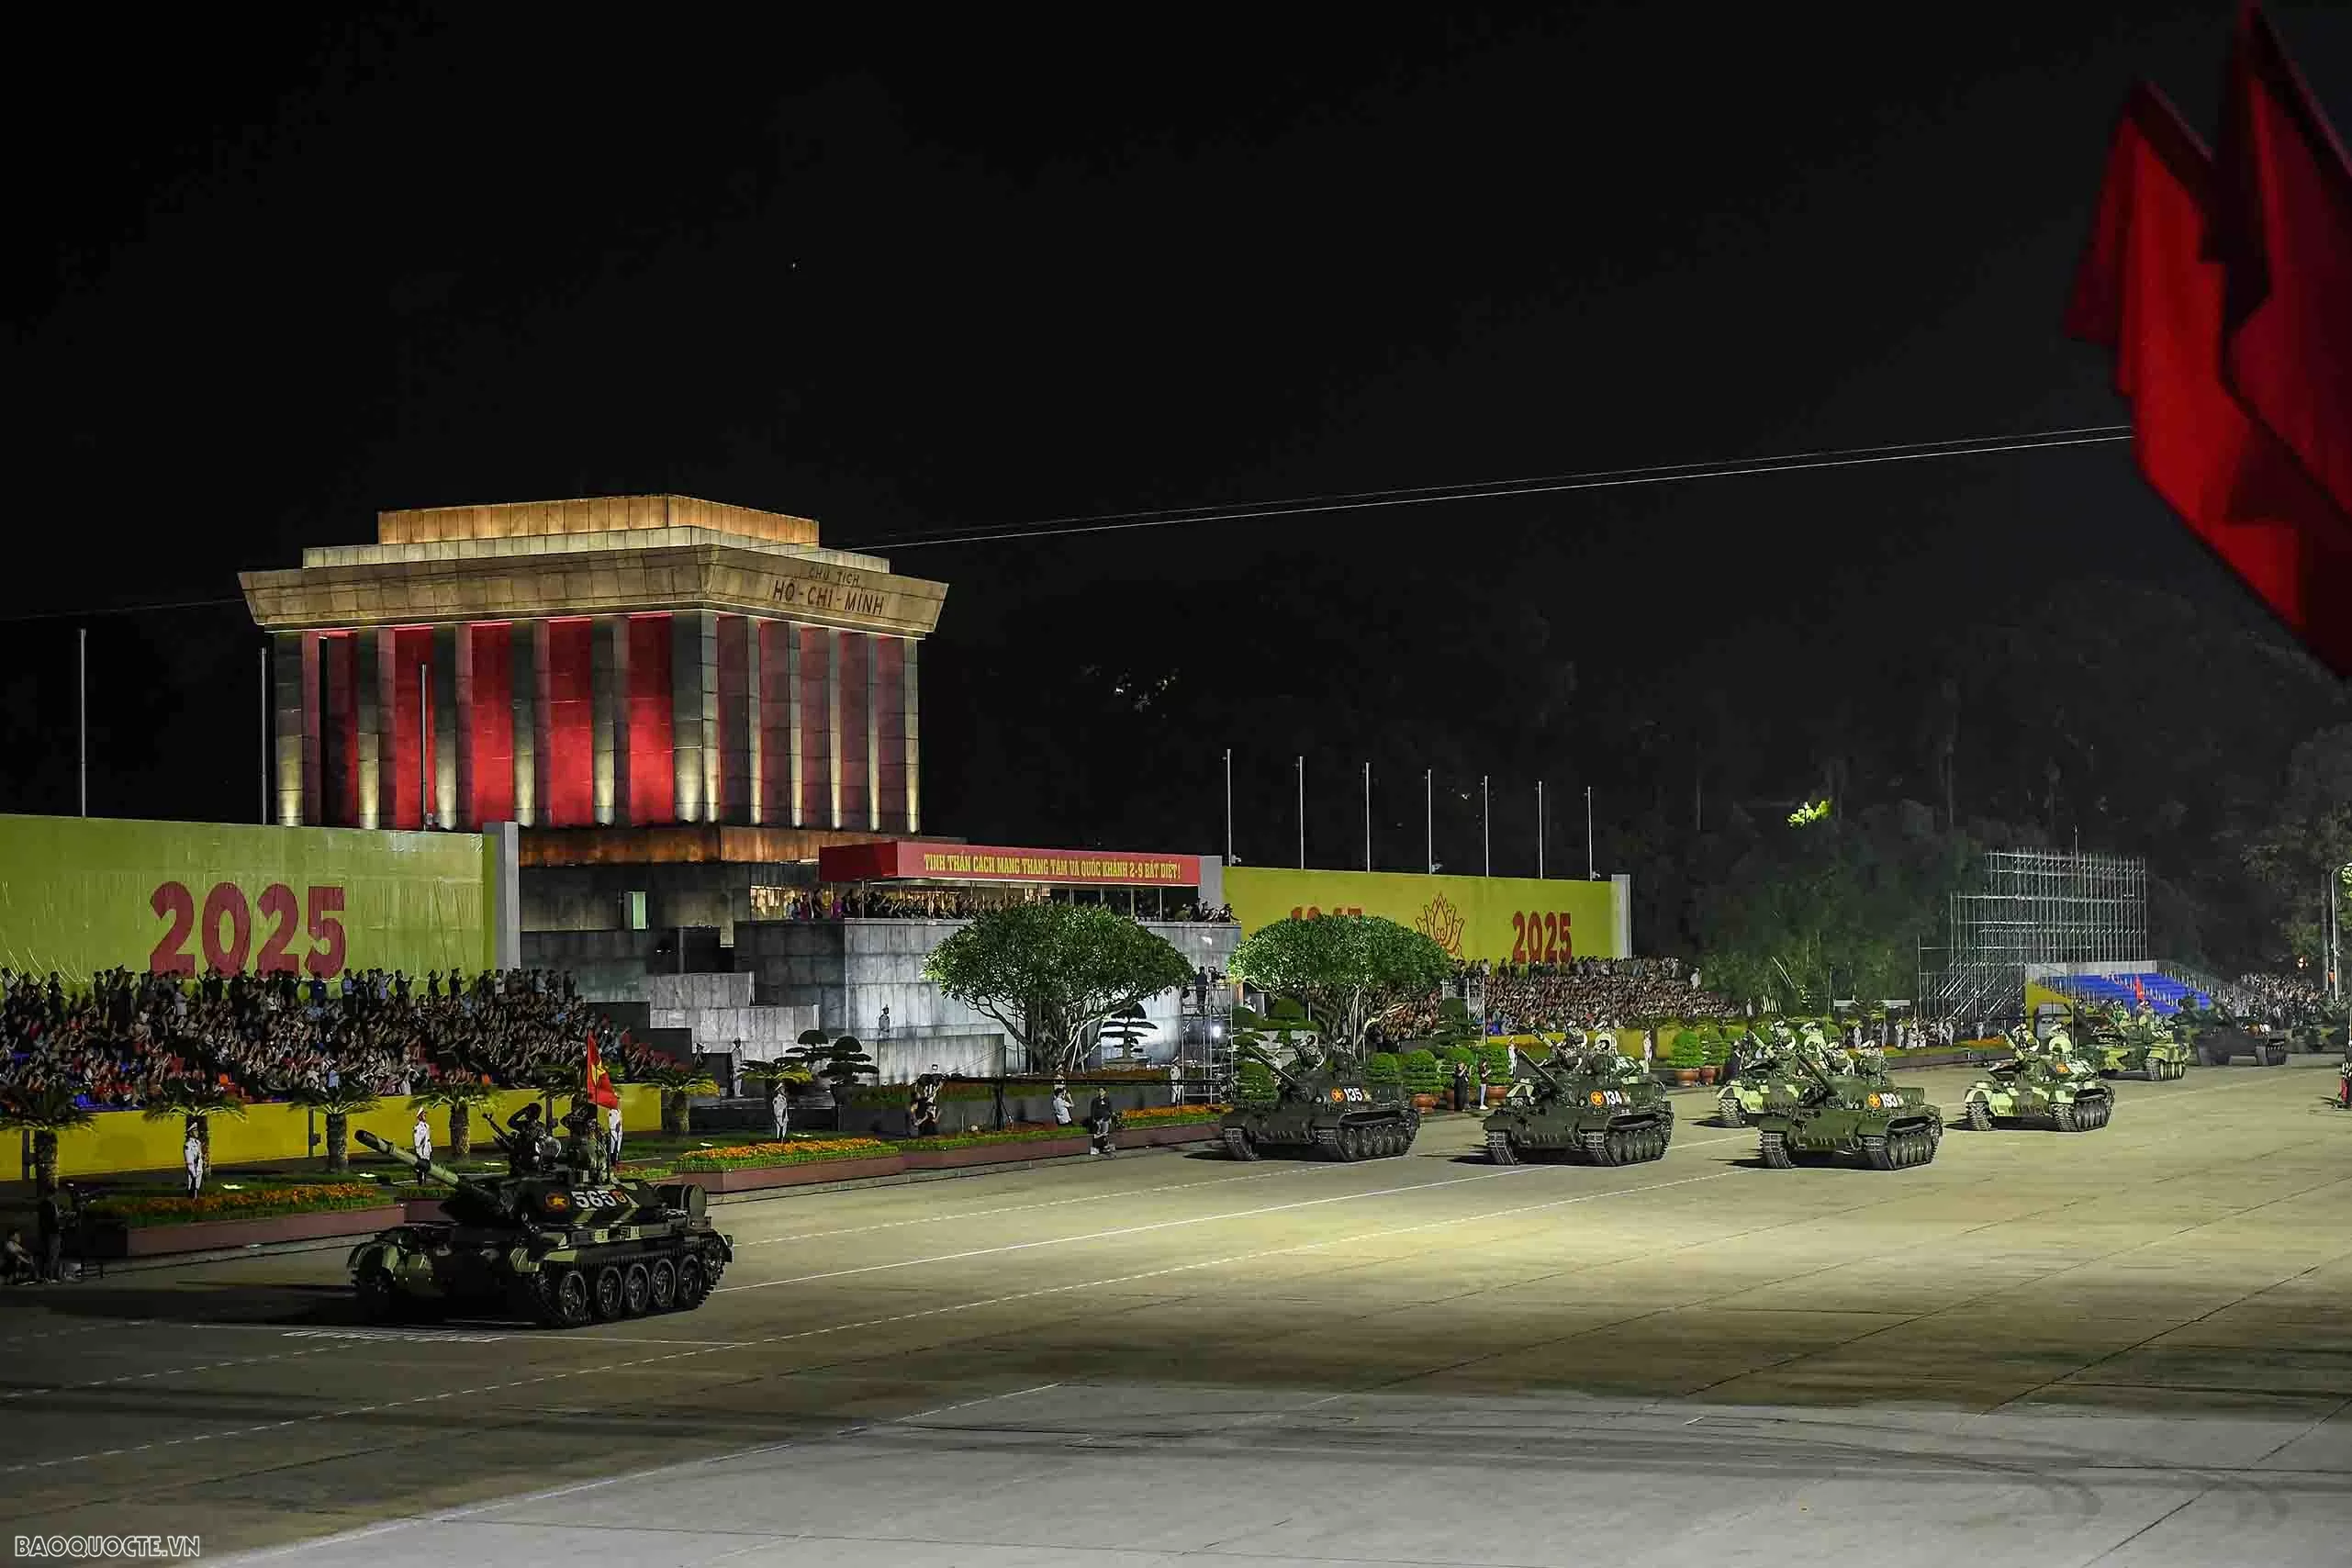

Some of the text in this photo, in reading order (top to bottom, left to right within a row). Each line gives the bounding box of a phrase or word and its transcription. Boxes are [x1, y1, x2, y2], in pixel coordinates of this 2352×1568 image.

[924, 854, 946, 871] TINH
[150, 880, 346, 979] 2025
[1512, 911, 1573, 963] 2025
[1343, 1086, 1363, 1102] 135
[571, 1190, 617, 1209] 565
